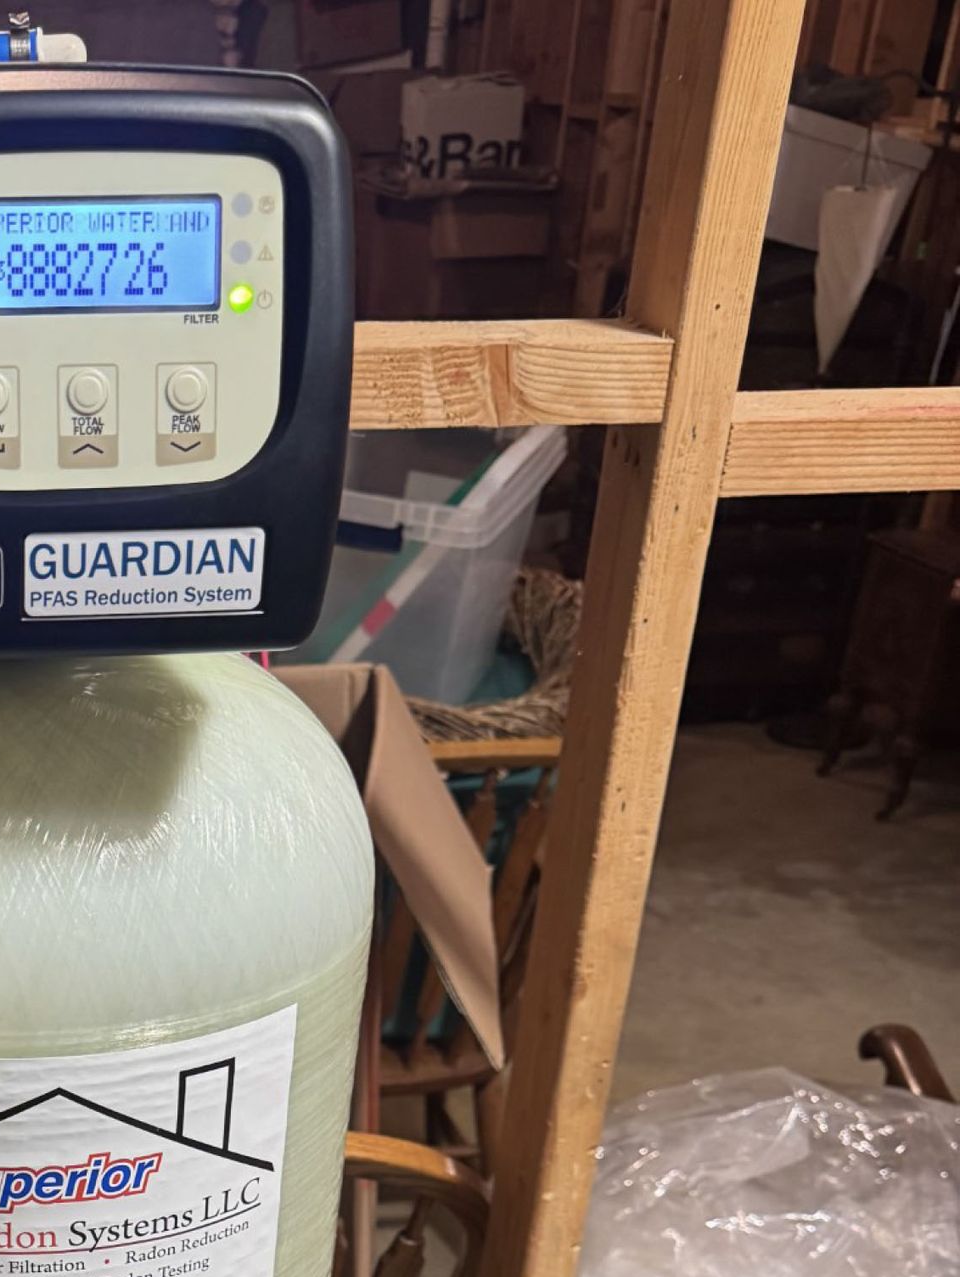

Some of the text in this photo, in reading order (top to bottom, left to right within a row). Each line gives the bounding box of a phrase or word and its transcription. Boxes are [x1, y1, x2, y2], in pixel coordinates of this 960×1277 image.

[88, 211, 156, 233] WATER
[7, 242, 169, 297] 8882726
[183, 314, 219, 325] FILTER
[72, 416, 104, 427] TOTAL
[73, 425, 103, 435] FLOW
[171, 423, 201, 433] FLOW
[172, 415, 200, 425] PEAK
[29, 538, 256, 580] GUARDIAN
[29, 584, 253, 608] PFAS Reduction System
[68, 1207, 193, 1252] Systems
[200, 1177, 261, 1222] LLC
[9, 1259, 85, 1274] Filtration
[126, 1246, 176, 1264] Radon
[180, 1220, 250, 1253] Reduction
